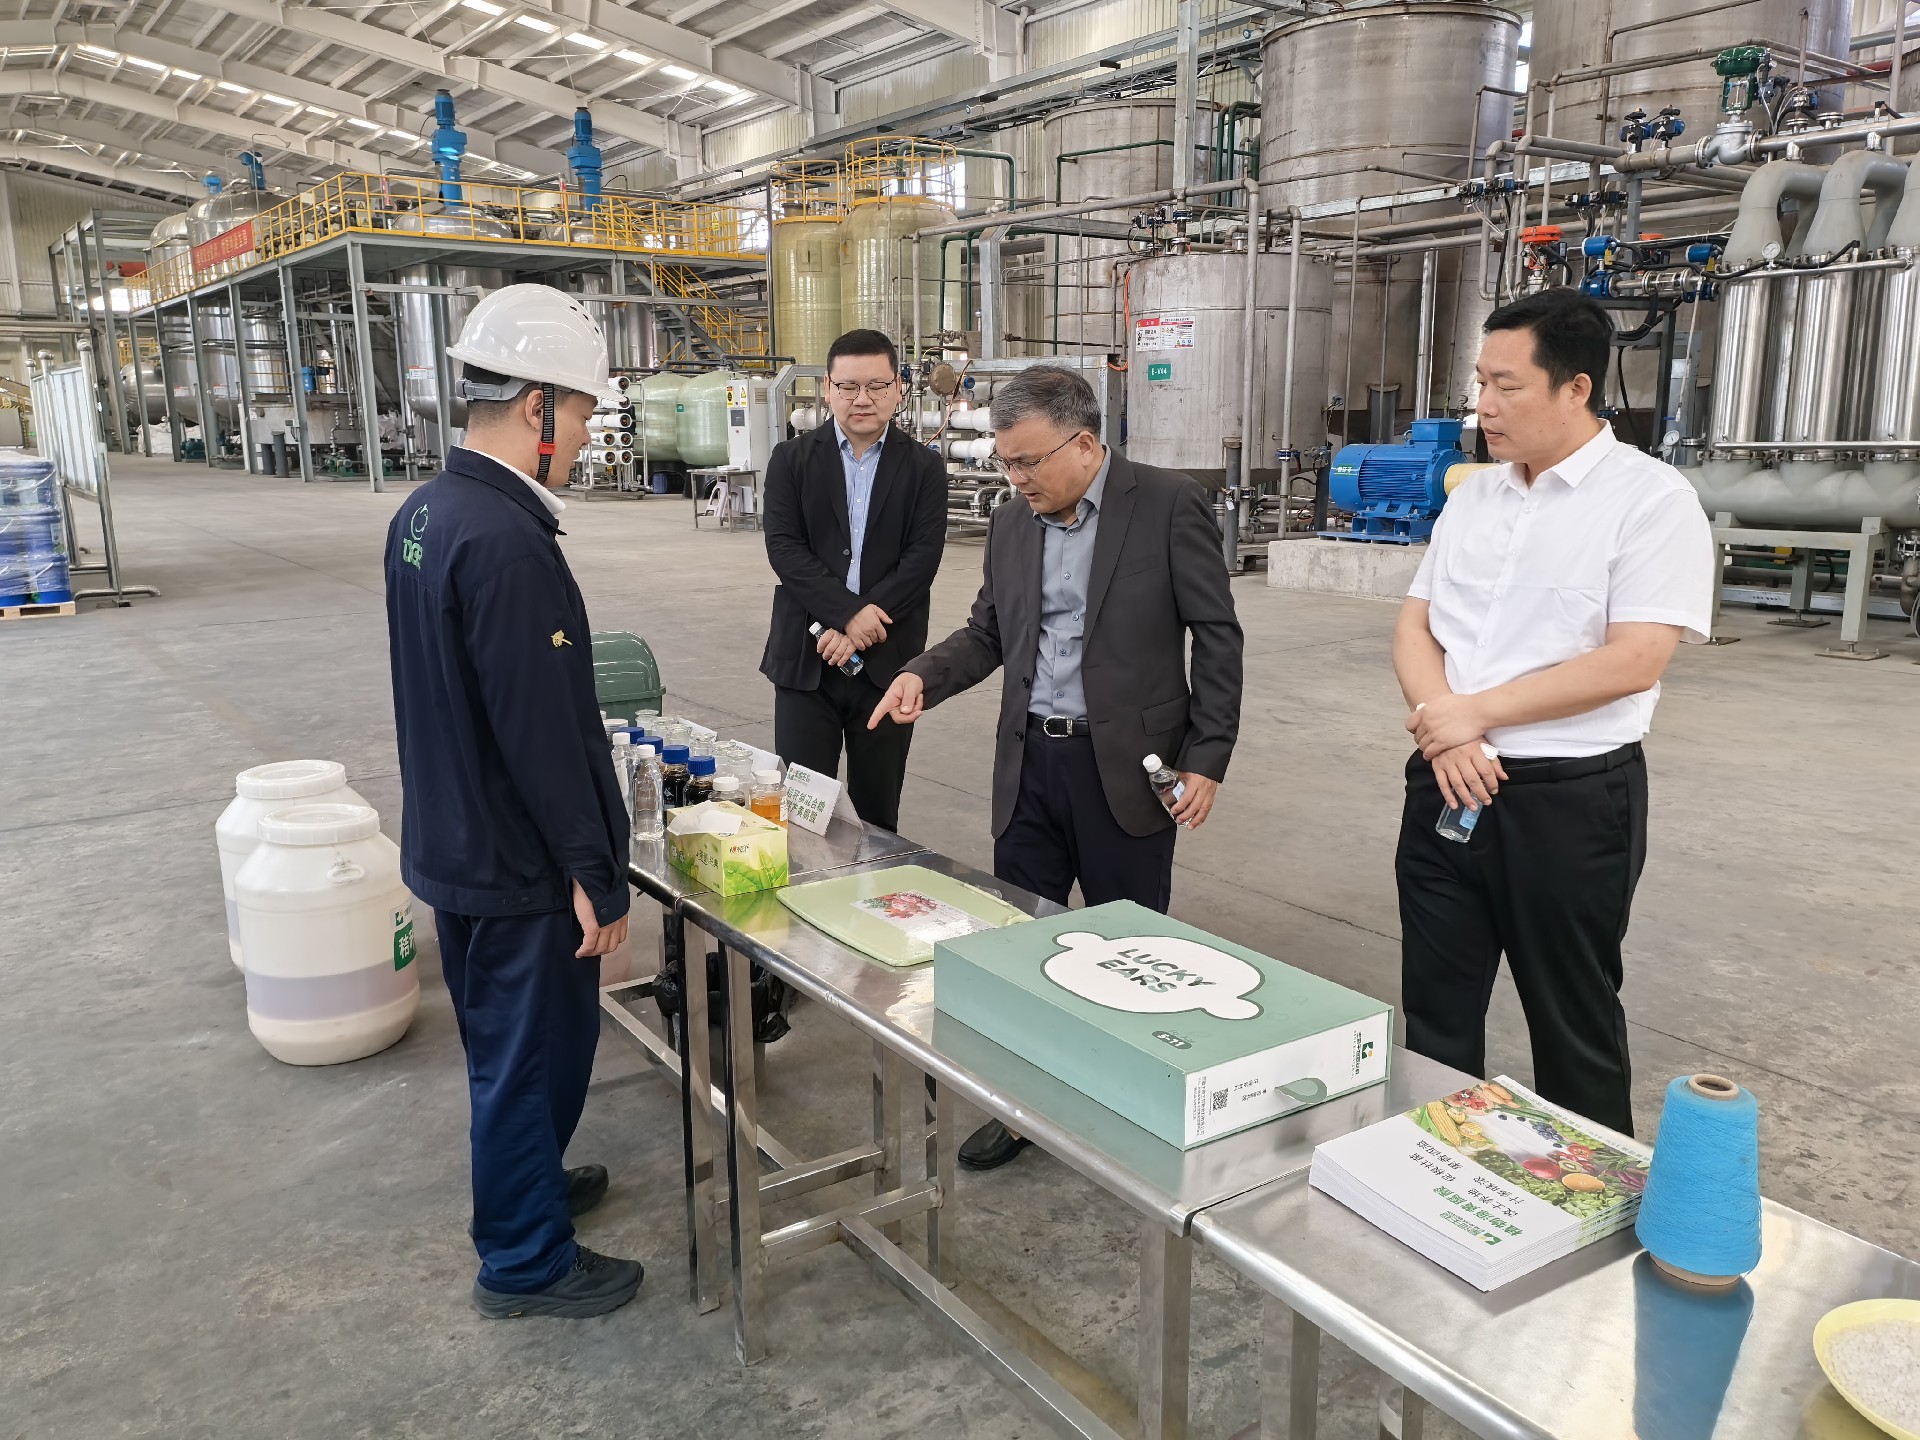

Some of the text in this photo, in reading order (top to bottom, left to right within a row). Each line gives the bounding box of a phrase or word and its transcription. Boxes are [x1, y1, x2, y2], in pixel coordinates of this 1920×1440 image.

[1096, 958, 1178, 993] EARS
[1116, 948, 1217, 987] LUCKY
[1156, 1033, 1186, 1047] 5-11
[1408, 1152, 1456, 1182] 促根壮苗
[1415, 1139, 1524, 1204] 汁多味浓 果香四溢
[1432, 1185, 1524, 1237] 植物源黄腐酸
